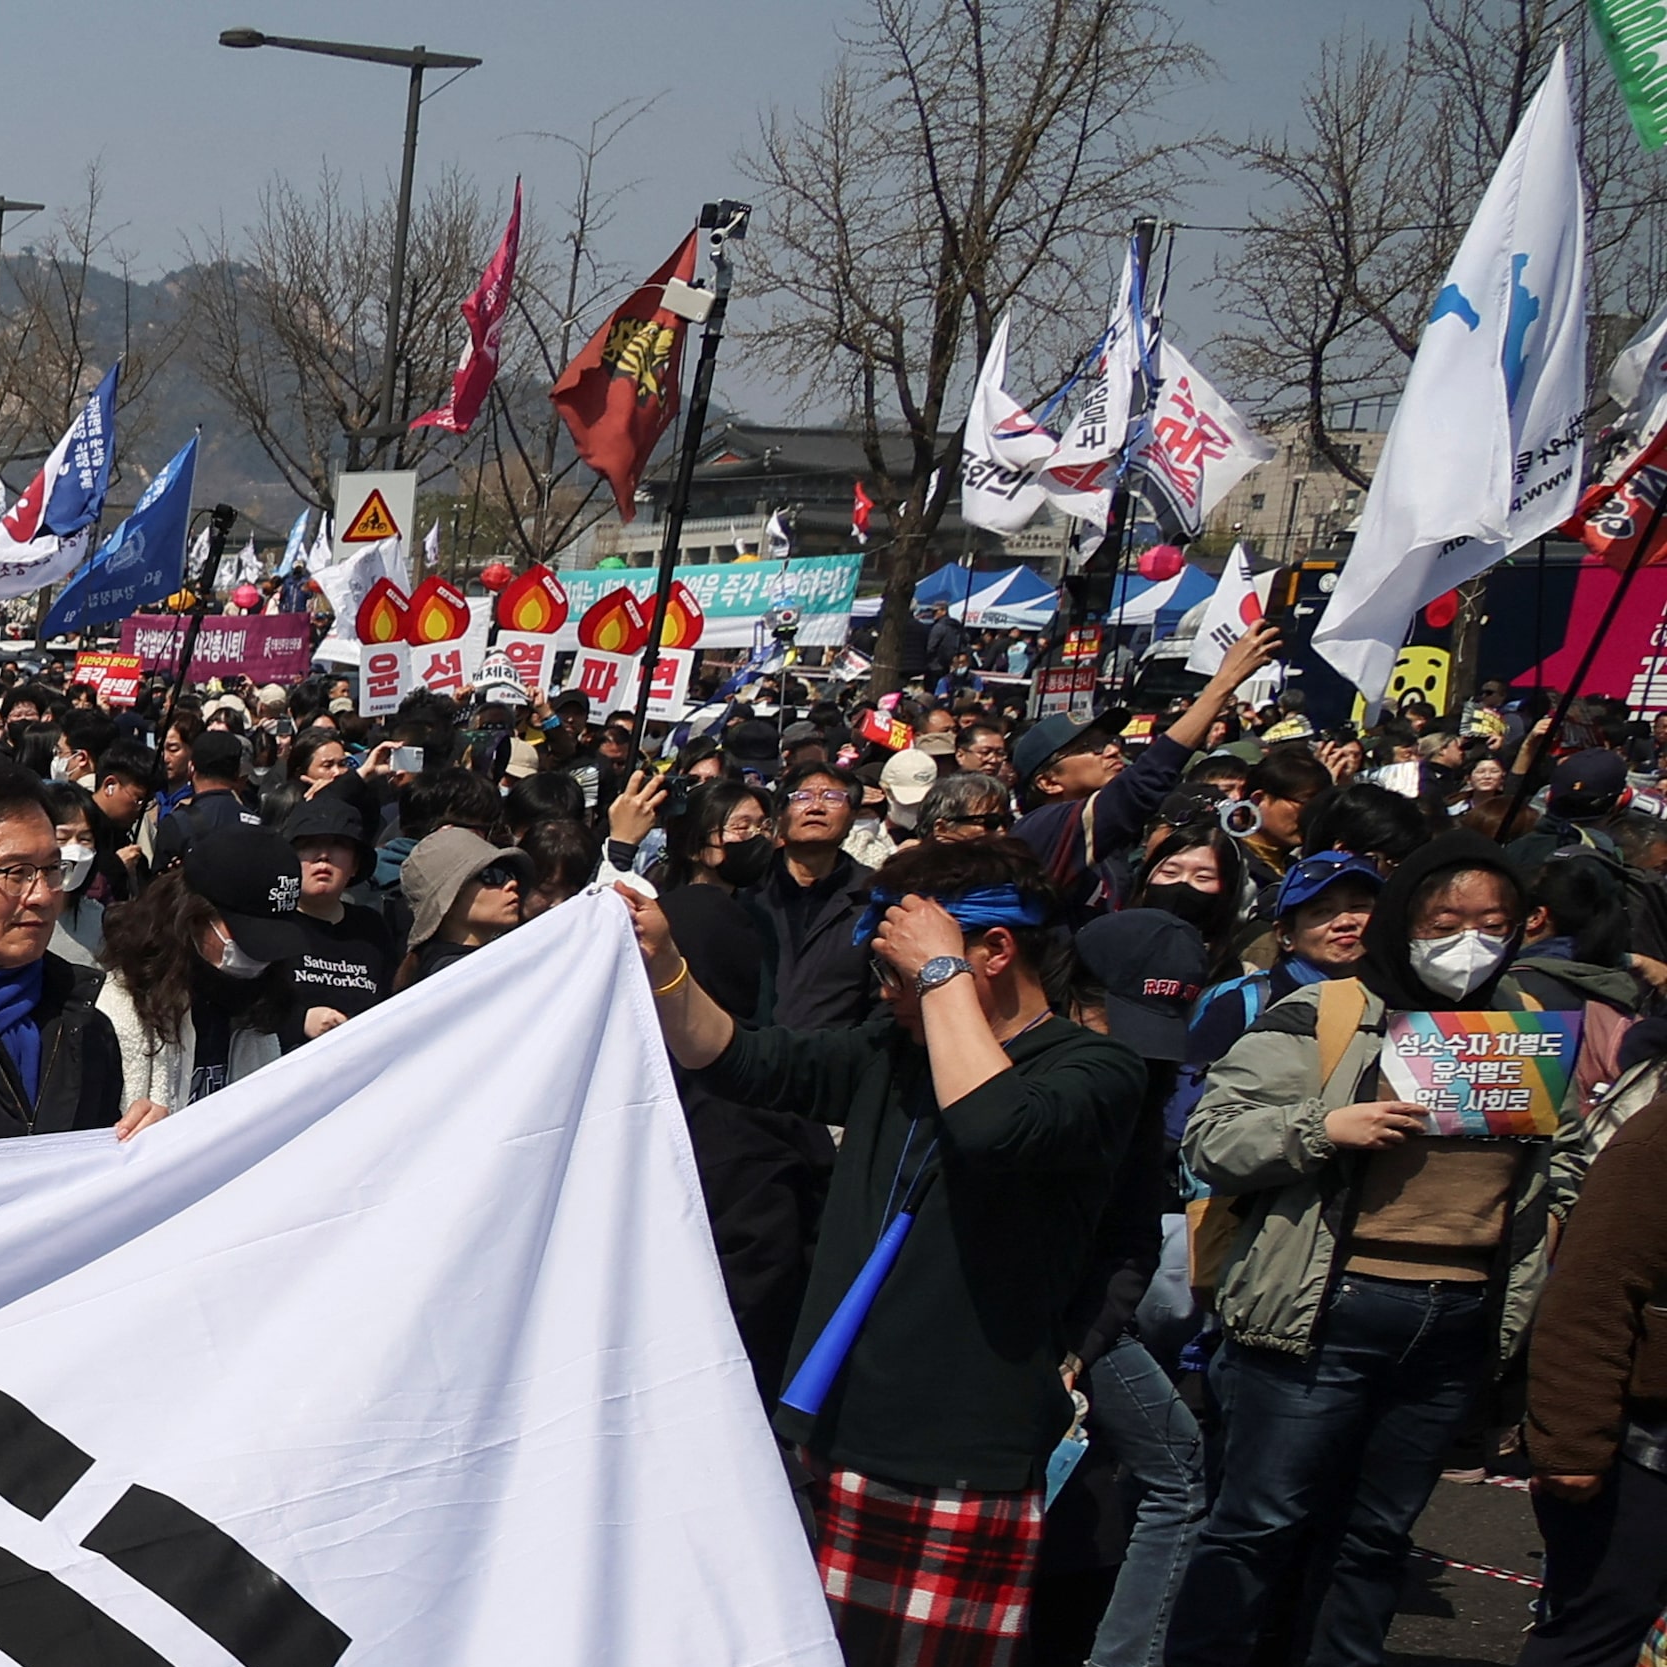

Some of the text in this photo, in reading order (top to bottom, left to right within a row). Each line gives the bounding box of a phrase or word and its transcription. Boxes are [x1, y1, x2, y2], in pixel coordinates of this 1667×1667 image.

[75, 666, 108, 685] 즉각
[99, 676, 138, 696] 탄핵!
[367, 653, 400, 699] 윤
[578, 657, 620, 704] 파
[303, 954, 369, 975] Saturdays
[1142, 978, 1181, 997] RED
[1397, 1032, 1564, 1058] 성소수자 차별도
[1431, 1060, 1524, 1085] 윤석열도
[1461, 1088, 1531, 1113] 사회로
